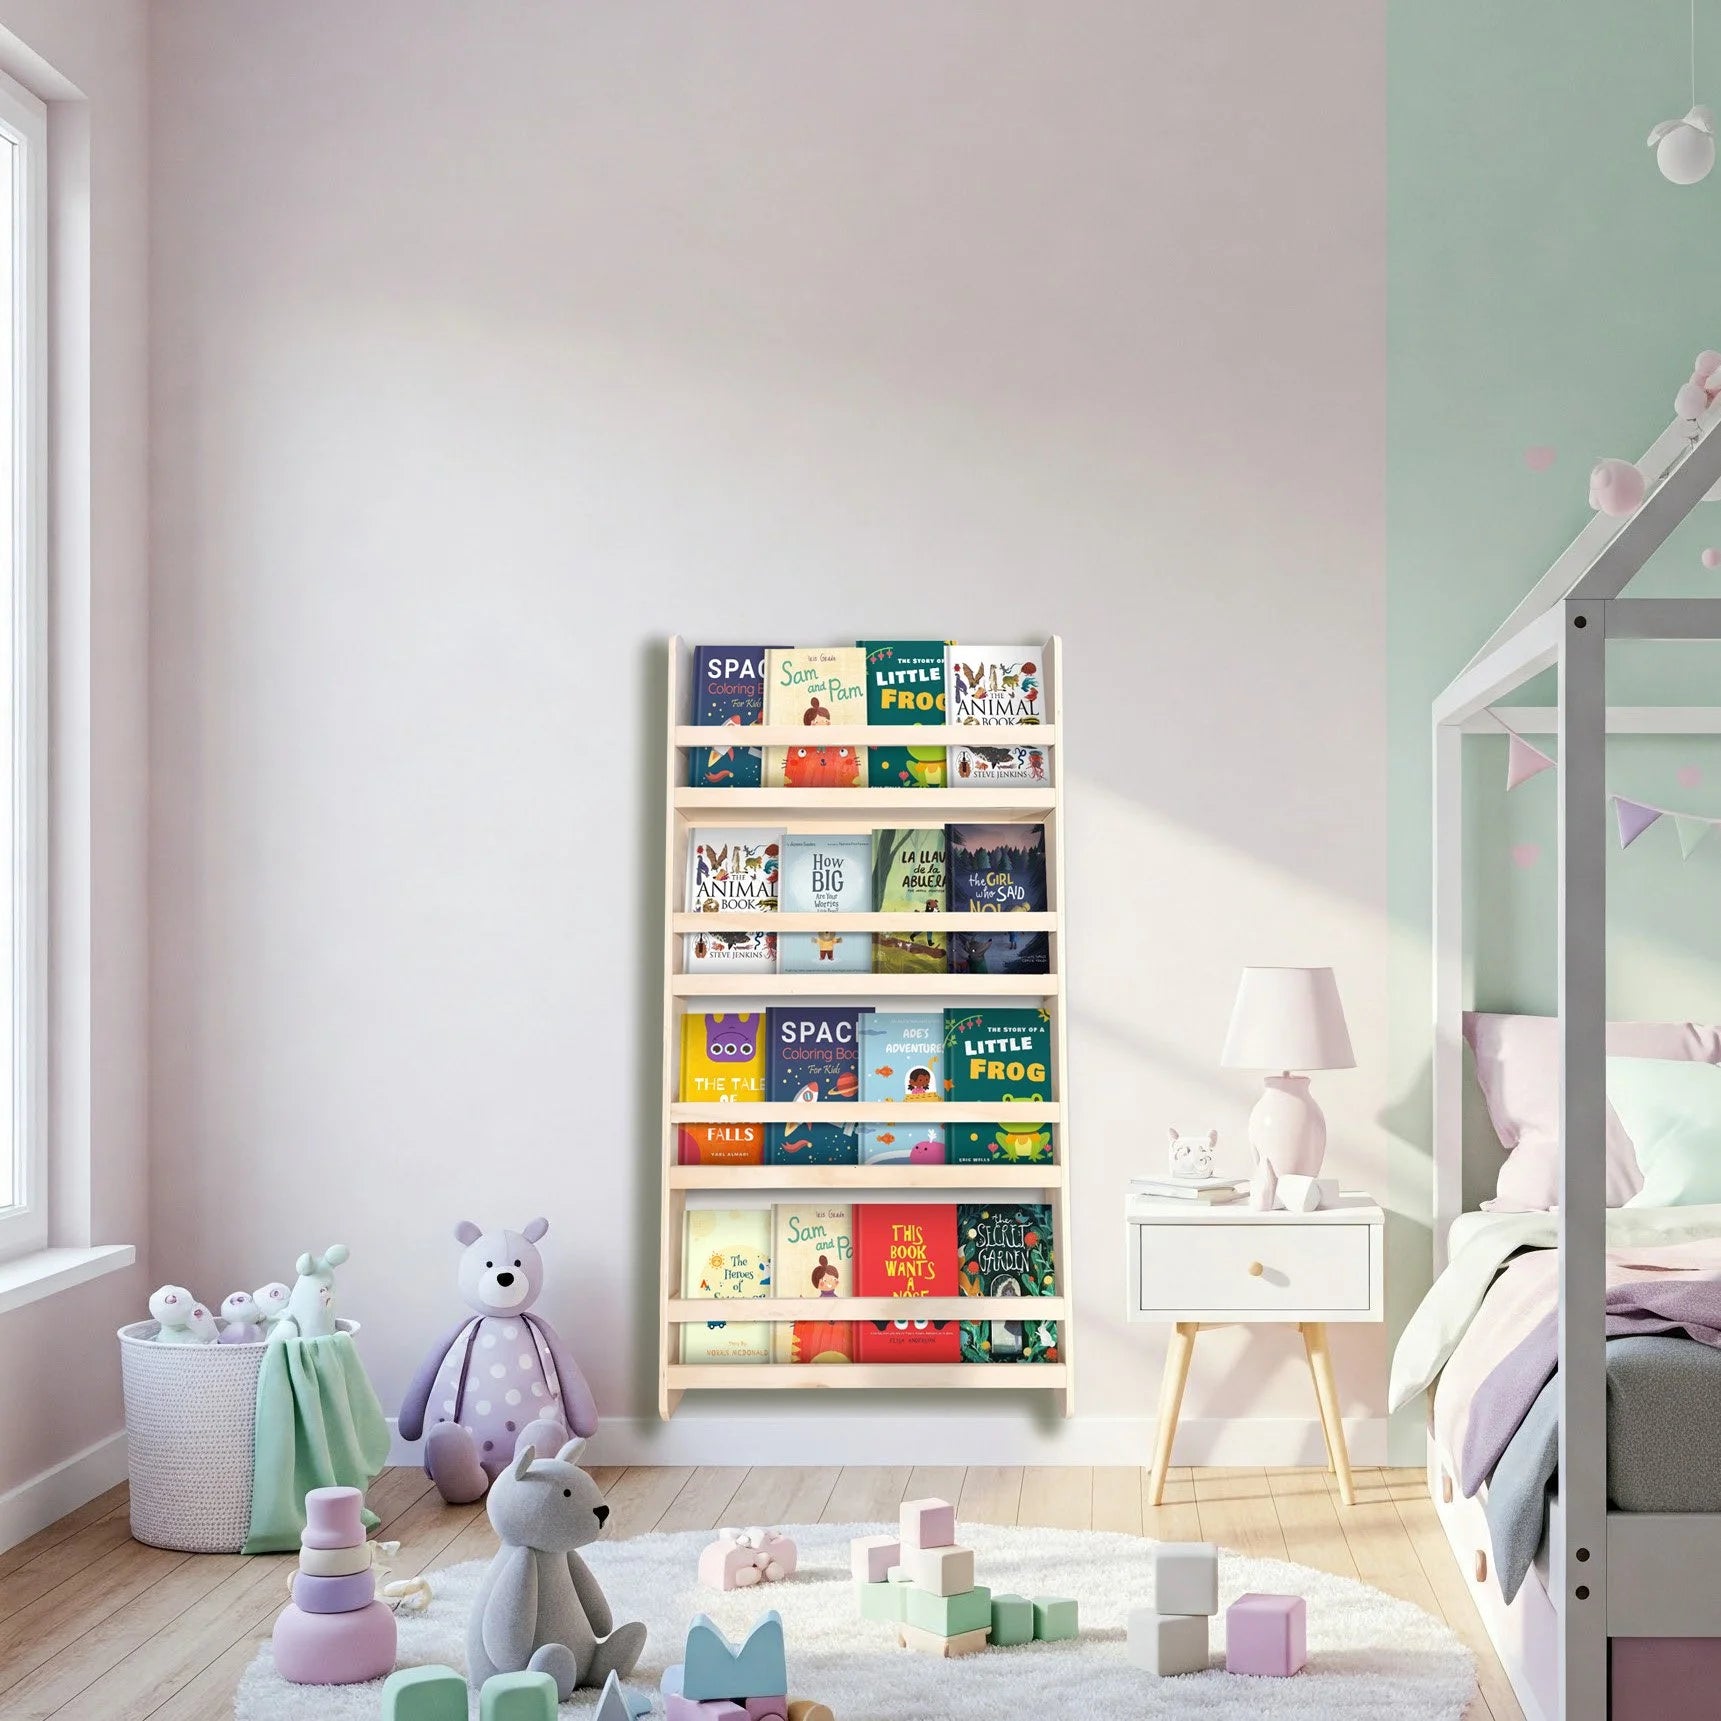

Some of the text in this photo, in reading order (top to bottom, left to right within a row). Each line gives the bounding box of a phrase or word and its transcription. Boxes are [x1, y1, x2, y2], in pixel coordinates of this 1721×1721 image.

[780, 660, 819, 687] Sam
[876, 667, 941, 687] LITTLE
[708, 682, 754, 697] Coloring
[807, 678, 864, 703] and Pam
[957, 699, 1040, 716] ANIMAL
[982, 717, 1016, 725] BOOK
[996, 771, 1028, 779] JENKINS
[813, 853, 844, 871] How
[902, 851, 915, 864] LA
[913, 863, 941, 874] de la
[812, 869, 844, 893] BIG
[968, 872, 1014, 887] the GIRL
[697, 881, 778, 898] ANIMAL
[976, 886, 1025, 902] who SAID
[721, 898, 756, 910] BOOK
[709, 951, 763, 960] STEVE JENKINS
[781, 1021, 859, 1043] SPAC
[964, 1036, 1033, 1056] LITTLE
[782, 1047, 833, 1063] Coloring
[807, 1063, 841, 1074] For Kids
[970, 1058, 1046, 1083] FROG
[694, 1077, 726, 1091] THE
[707, 1127, 754, 1142] FALLS
[992, 1214, 1012, 1224] the
[787, 1216, 827, 1243] Sam
[892, 1224, 924, 1245] THIS
[976, 1222, 1033, 1249] SECRET
[816, 1238, 835, 1251] and
[890, 1245, 927, 1260] BOOK
[730, 1254, 748, 1267] The
[978, 1248, 1029, 1275] GARDEN
[885, 1260, 936, 1280] WANTS
[732, 1279, 744, 1293] of
[907, 1277, 915, 1291] A
